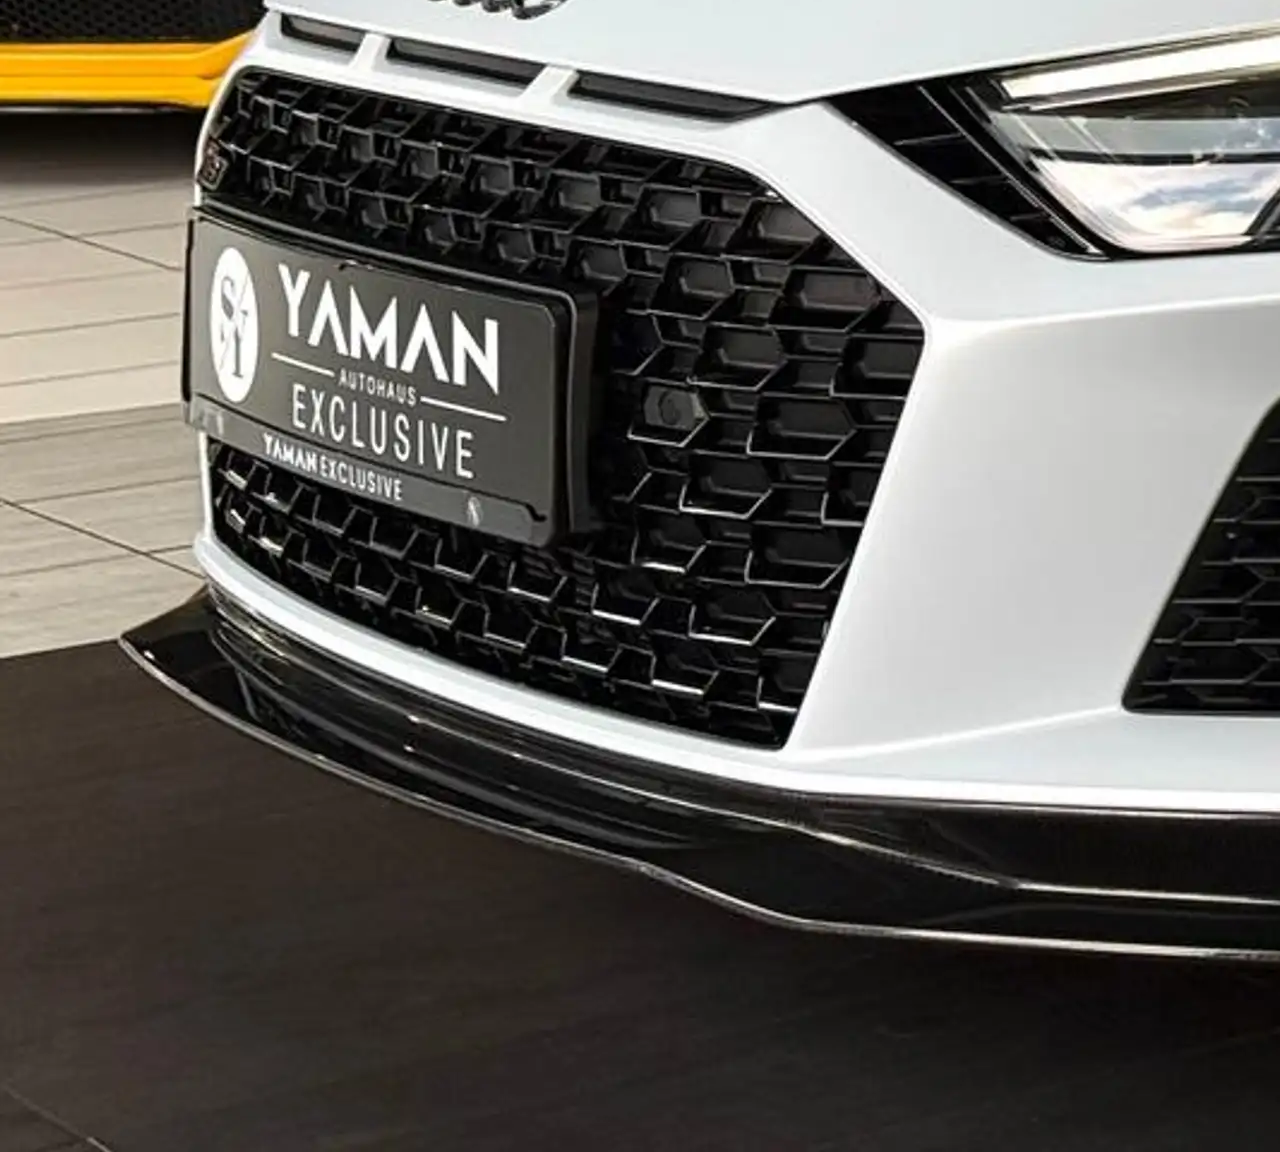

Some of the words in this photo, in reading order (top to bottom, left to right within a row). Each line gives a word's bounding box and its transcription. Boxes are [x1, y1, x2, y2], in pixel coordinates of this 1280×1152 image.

[277, 263, 499, 395] YAMAN
[292, 383, 475, 480] EXCLUSIVE
[339, 368, 417, 407] AUTOHAUS
